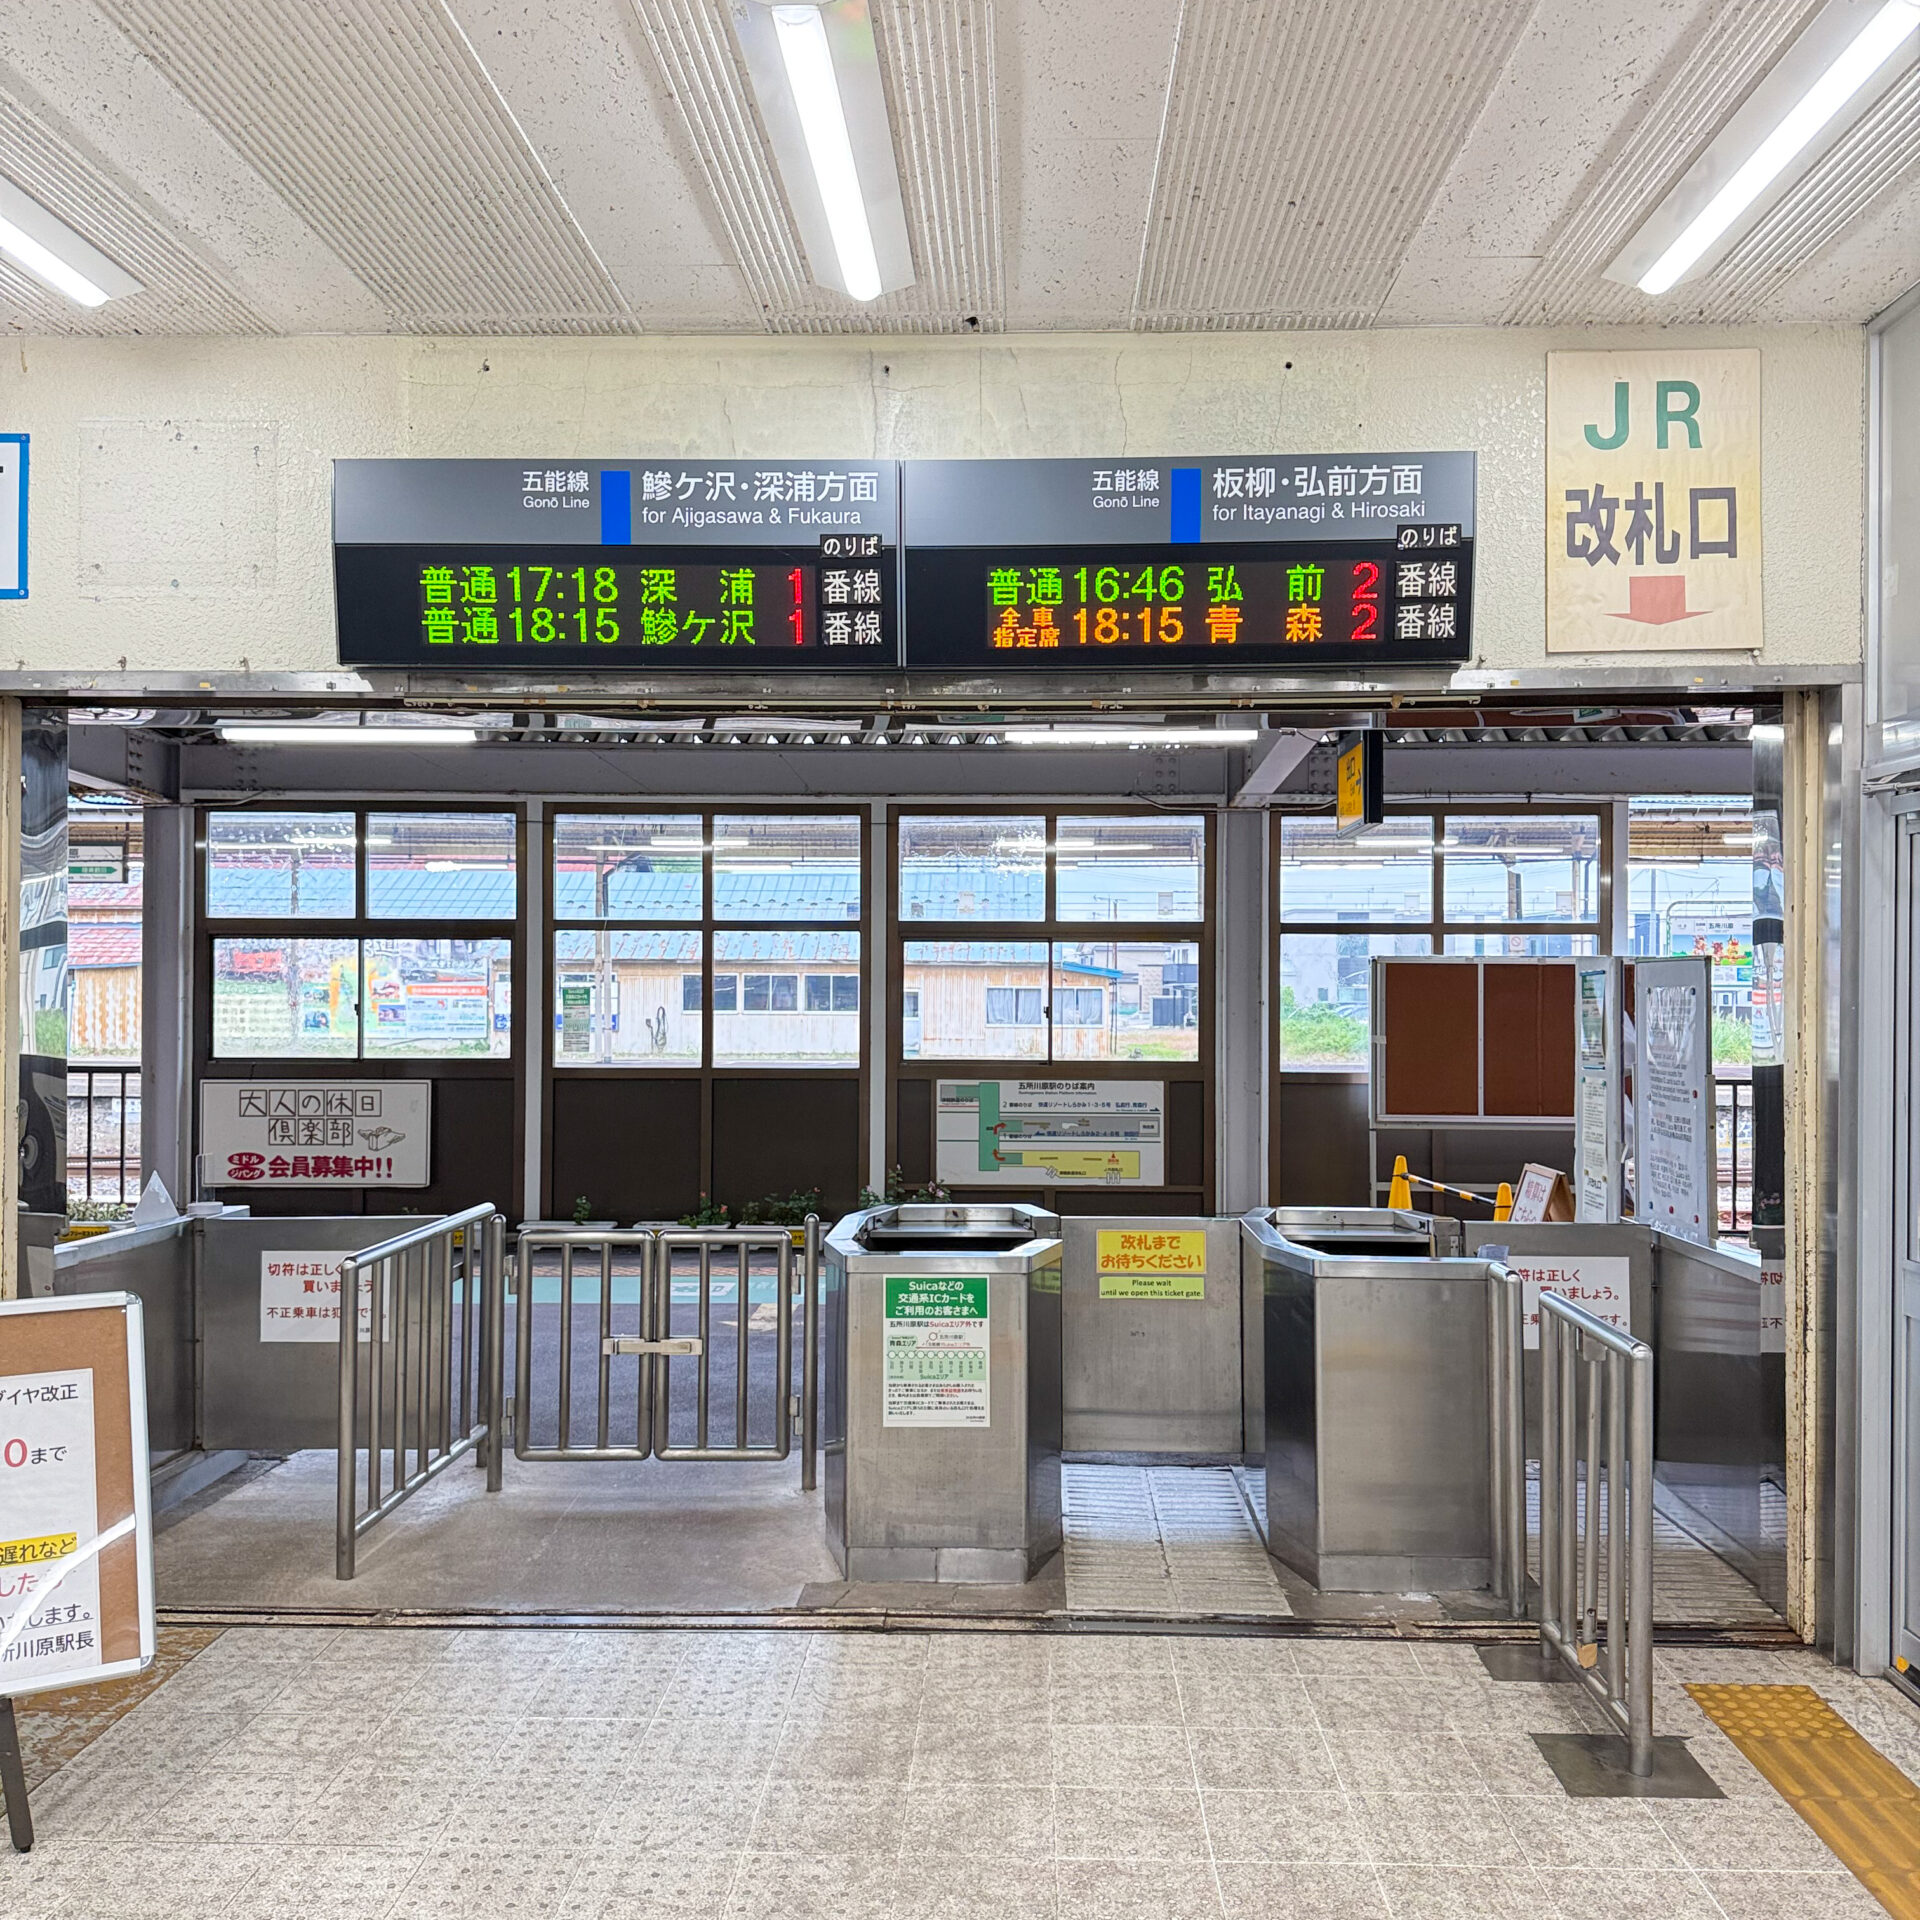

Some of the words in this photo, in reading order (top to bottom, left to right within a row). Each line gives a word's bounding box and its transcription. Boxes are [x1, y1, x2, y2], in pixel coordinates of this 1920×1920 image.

[1584, 380, 1703, 450] JR
[521, 470, 590, 493] 五能線
[1091, 469, 1160, 492] 五能線
[1212, 464, 1424, 499] 板柳・弘前方面
[562, 496, 590, 509] Line
[1132, 495, 1160, 508] Line
[1212, 504, 1237, 521] for
[1243, 503, 1326, 524] Itayanagi
[1331, 502, 1345, 519] &
[1351, 500, 1426, 519] Hirosaki
[642, 507, 667, 524] for
[671, 507, 764, 528] Ajigasawa
[768, 508, 782, 524] &
[788, 507, 862, 525] Fukaura
[1565, 481, 1738, 567] 改札口
[823, 536, 878, 556] のりば
[1401, 526, 1458, 548] のりば
[420, 566, 498, 604] 普通
[507, 566, 619, 603] 17:18
[788, 568, 802, 604] 1
[823, 569, 882, 605] 番線
[987, 568, 1064, 605] 普通
[1073, 566, 1185, 603] 16:46
[1352, 561, 1379, 599] 2
[1398, 560, 1458, 597] 番線
[421, 606, 499, 644] 普通
[508, 606, 620, 644] 18:15
[788, 608, 803, 645] 1
[824, 610, 883, 645] 番線
[1073, 607, 1184, 644] 18:15
[1351, 603, 1378, 640] 2
[1397, 602, 1457, 640] 番線
[993, 627, 1061, 648] 指定席
[1018, 1082, 1095, 1091] 五所川原駅のりば案内
[240, 1090, 380, 1117] 大人の休日
[268, 1119, 353, 1147] 倶楽部
[231, 1154, 260, 1165] ミドル
[1121, 1234, 1181, 1250] 改札まで
[1101, 1254, 1202, 1269] お待ちください
[908, 1281, 965, 1290] Suicaなどの
[1130, 1290, 1149, 1298] open
[1164, 1289, 1184, 1297] ticket
[898, 1293, 976, 1304] 交通系ICカードを
[895, 1305, 979, 1316] ご利用のお客さまへ
